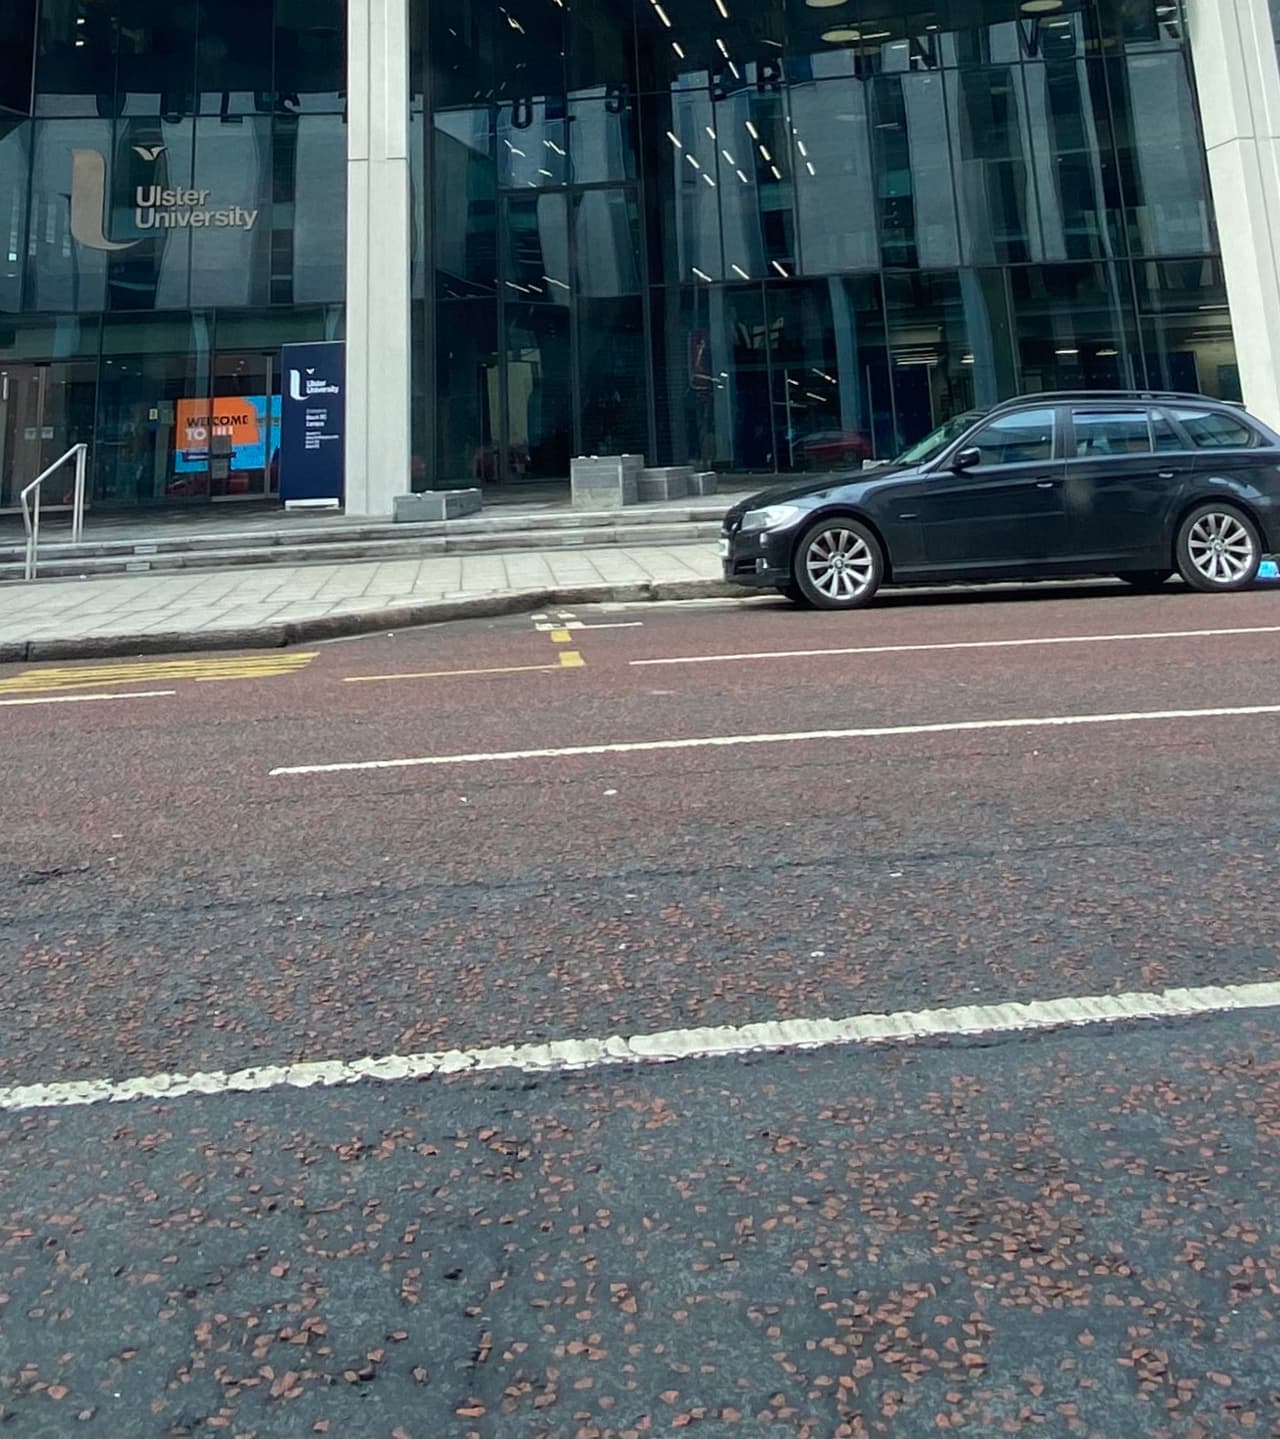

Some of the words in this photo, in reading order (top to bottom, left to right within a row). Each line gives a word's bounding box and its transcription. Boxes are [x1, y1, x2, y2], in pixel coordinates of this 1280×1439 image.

[136, 186, 210, 207] Ulster
[135, 206, 258, 230] University
[186, 415, 248, 428] WELCOME
[186, 428, 207, 440] TO
